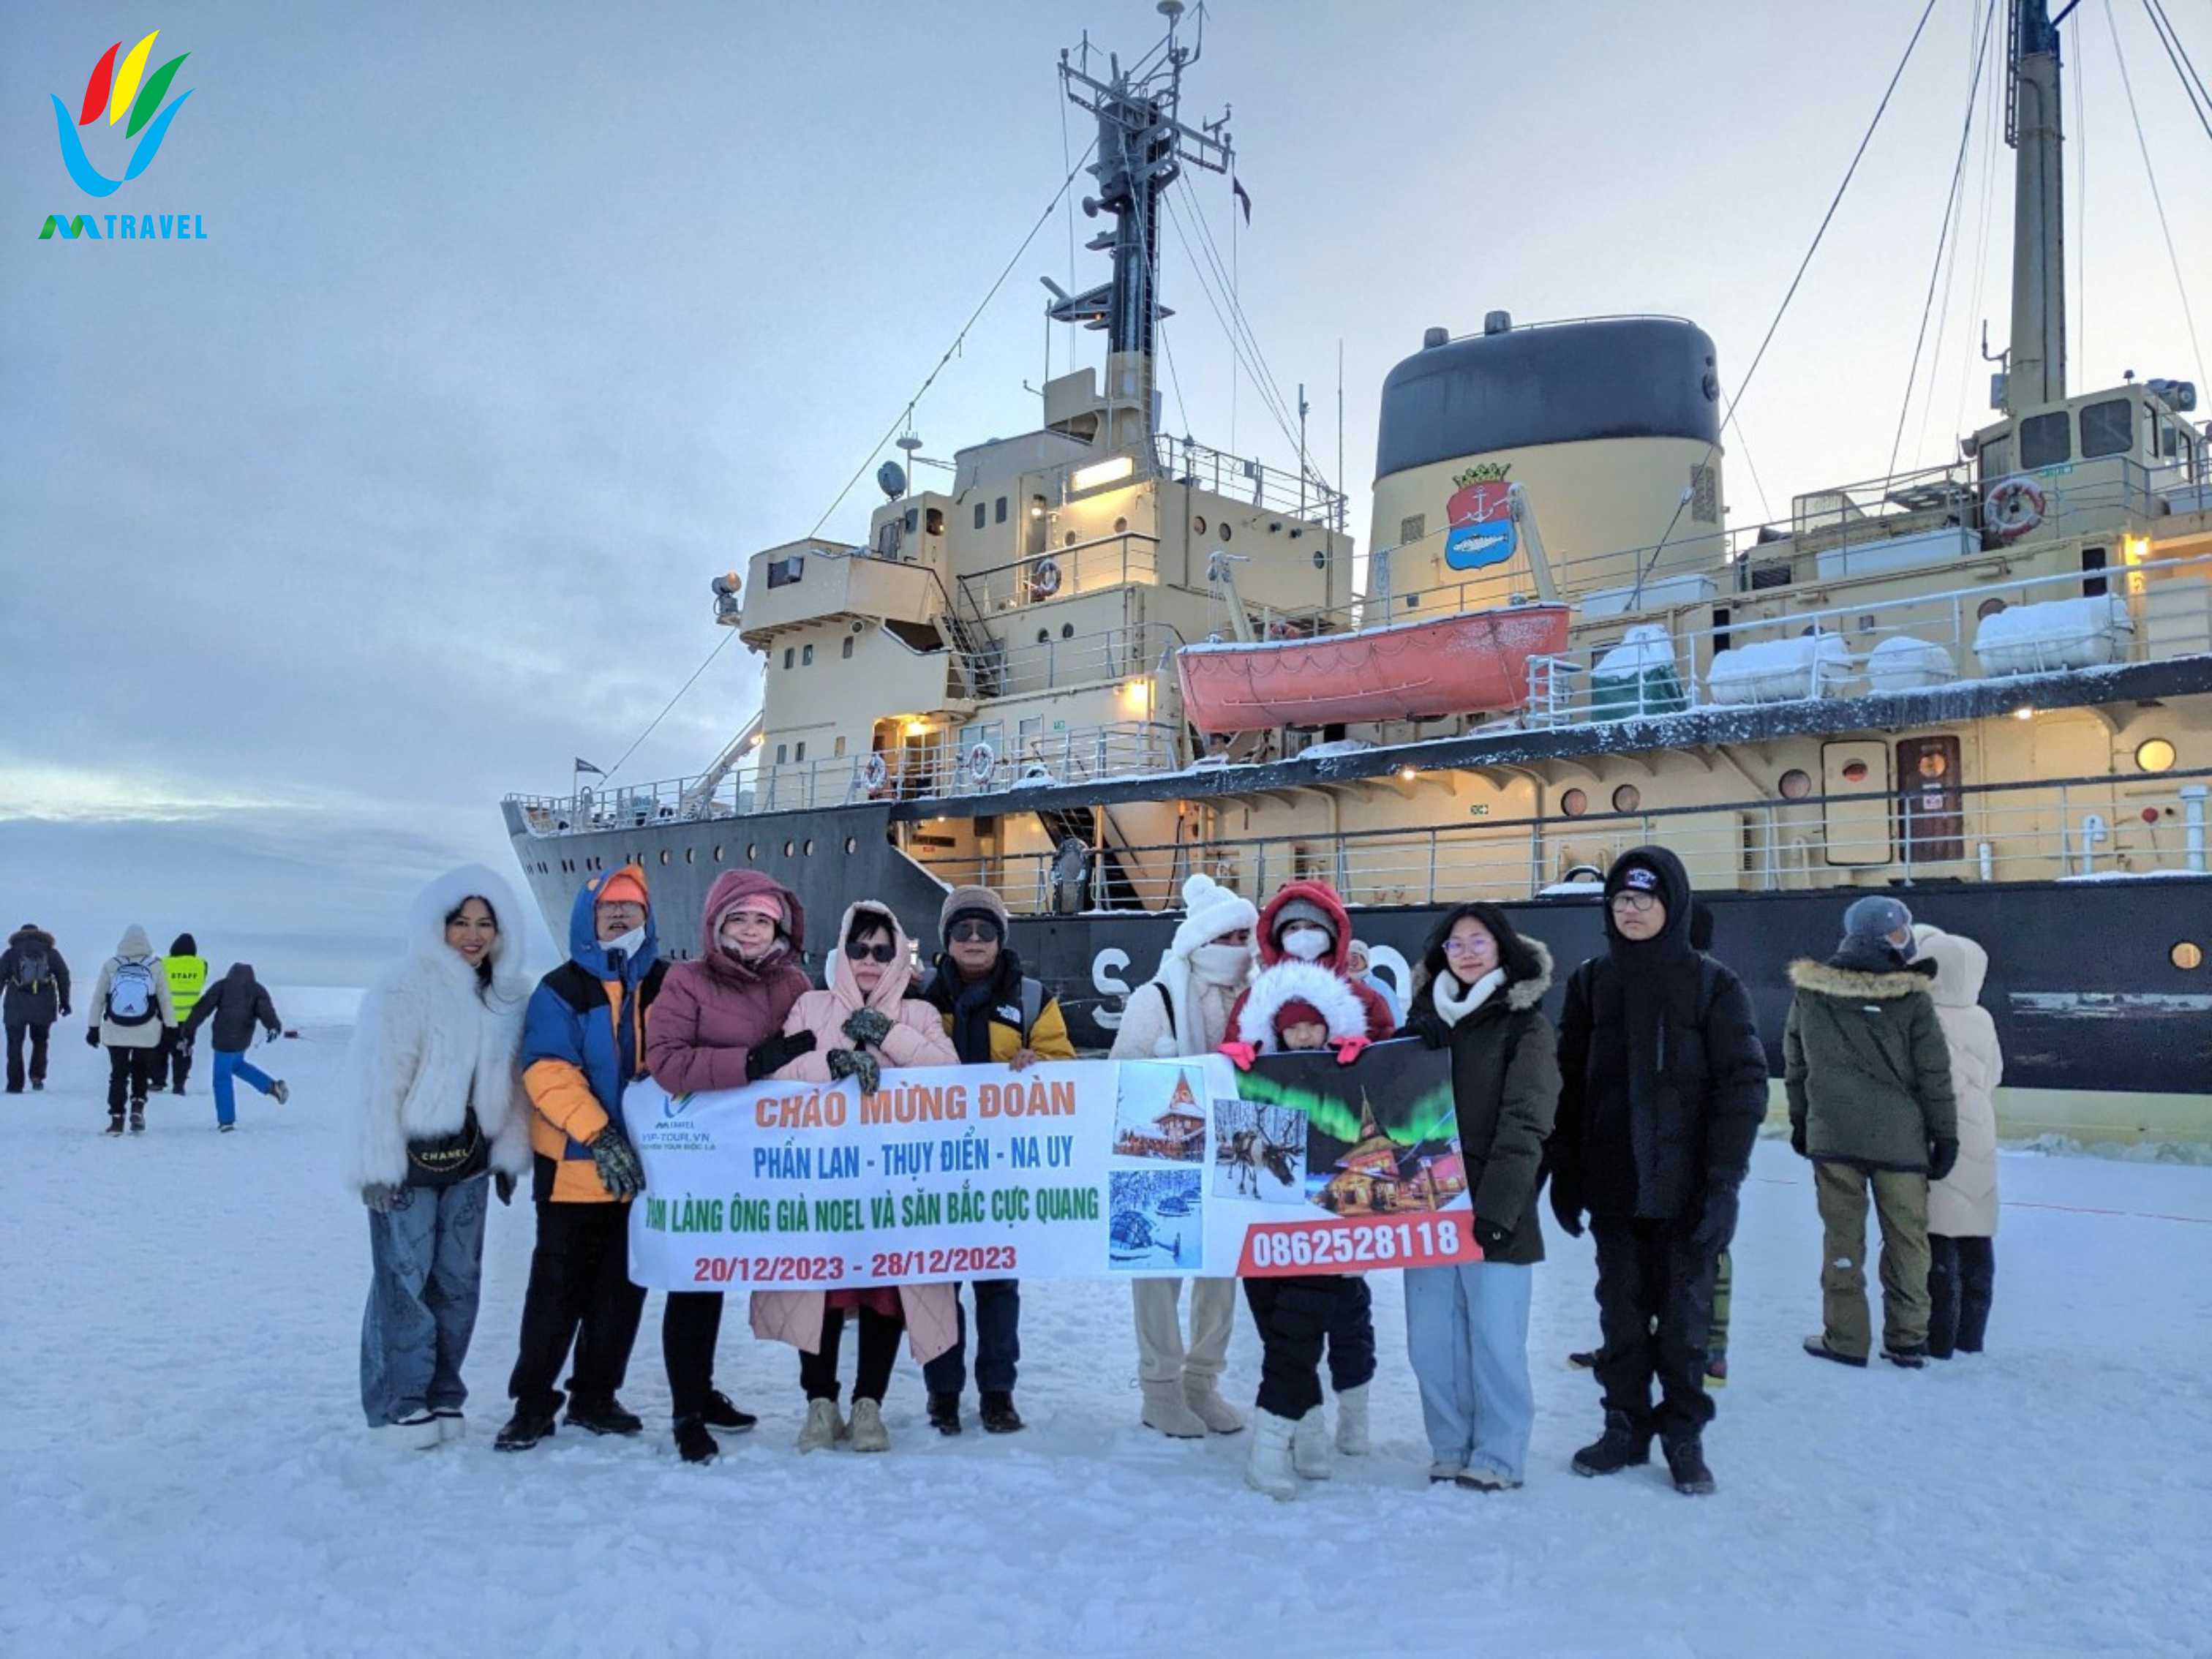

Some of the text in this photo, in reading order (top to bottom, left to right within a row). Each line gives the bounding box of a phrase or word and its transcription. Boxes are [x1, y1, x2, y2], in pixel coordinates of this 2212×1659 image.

[755, 1074, 1075, 1128] CHÀO MỪNG ĐOÀN
[421, 1148, 469, 1161] CHANEL
[753, 1135, 811, 1179] PHẦN
[819, 1146, 859, 1179] LAN
[881, 1142, 934, 1181] THỤY
[940, 1125, 990, 1172] ĐIỂN
[1011, 1137, 1041, 1168] NA
[1047, 1135, 1073, 1167] UY
[672, 1192, 723, 1233] LÀNG
[729, 1192, 770, 1232] ÔNG
[777, 1192, 809, 1232] GIÀ
[815, 1199, 865, 1232] NOEL
[870, 1189, 895, 1230] VÀ
[902, 1188, 941, 1227] SĂN
[947, 1179, 985, 1224] BẮC
[992, 1188, 1030, 1228] CỰC
[1036, 1187, 1099, 1222] QUANG
[694, 1257, 844, 1282] 20/12/2023
[872, 1246, 1017, 1277] 28/12/2023
[1252, 1219, 1460, 1268] 0862528118
